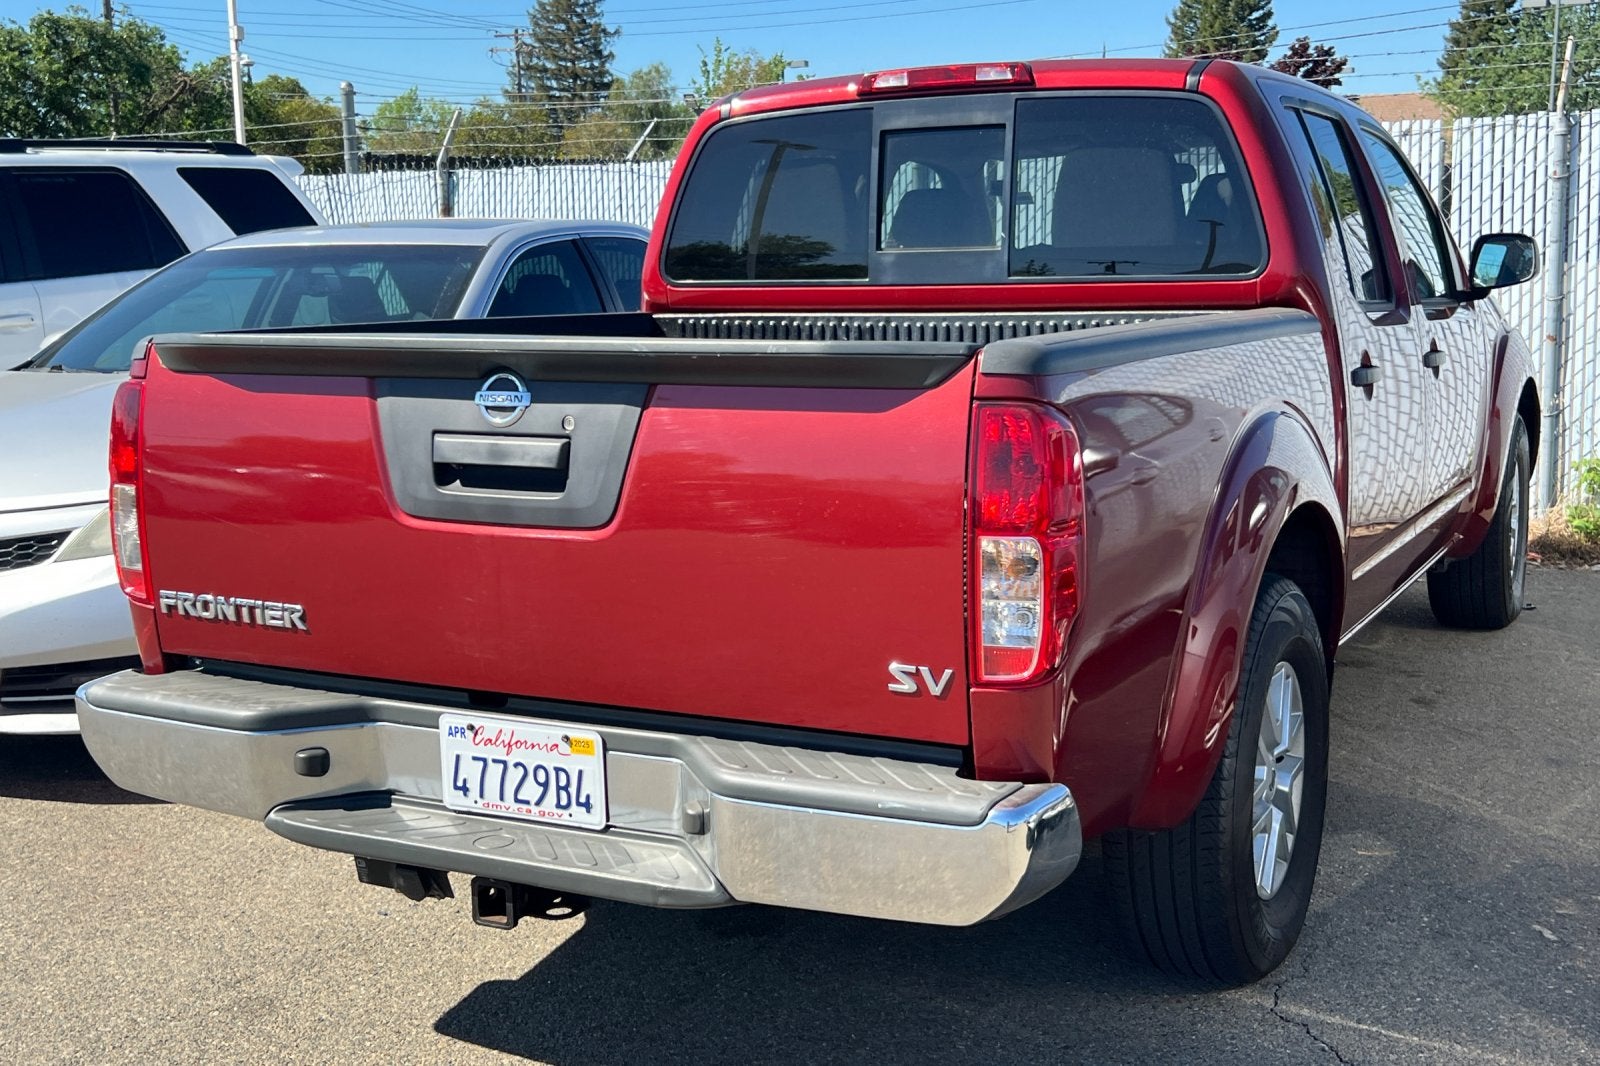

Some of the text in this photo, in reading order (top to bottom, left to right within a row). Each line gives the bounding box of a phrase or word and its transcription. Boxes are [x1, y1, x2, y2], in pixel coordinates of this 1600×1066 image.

[478, 393, 523, 404] NISSAN
[159, 589, 307, 631] FRONTIER
[887, 661, 953, 697] SV
[447, 725, 467, 740] APR
[471, 725, 571, 757] California
[573, 739, 590, 749] 2025
[453, 754, 593, 814] 47729B4
[482, 801, 564, 819] dmv.ca.gov
